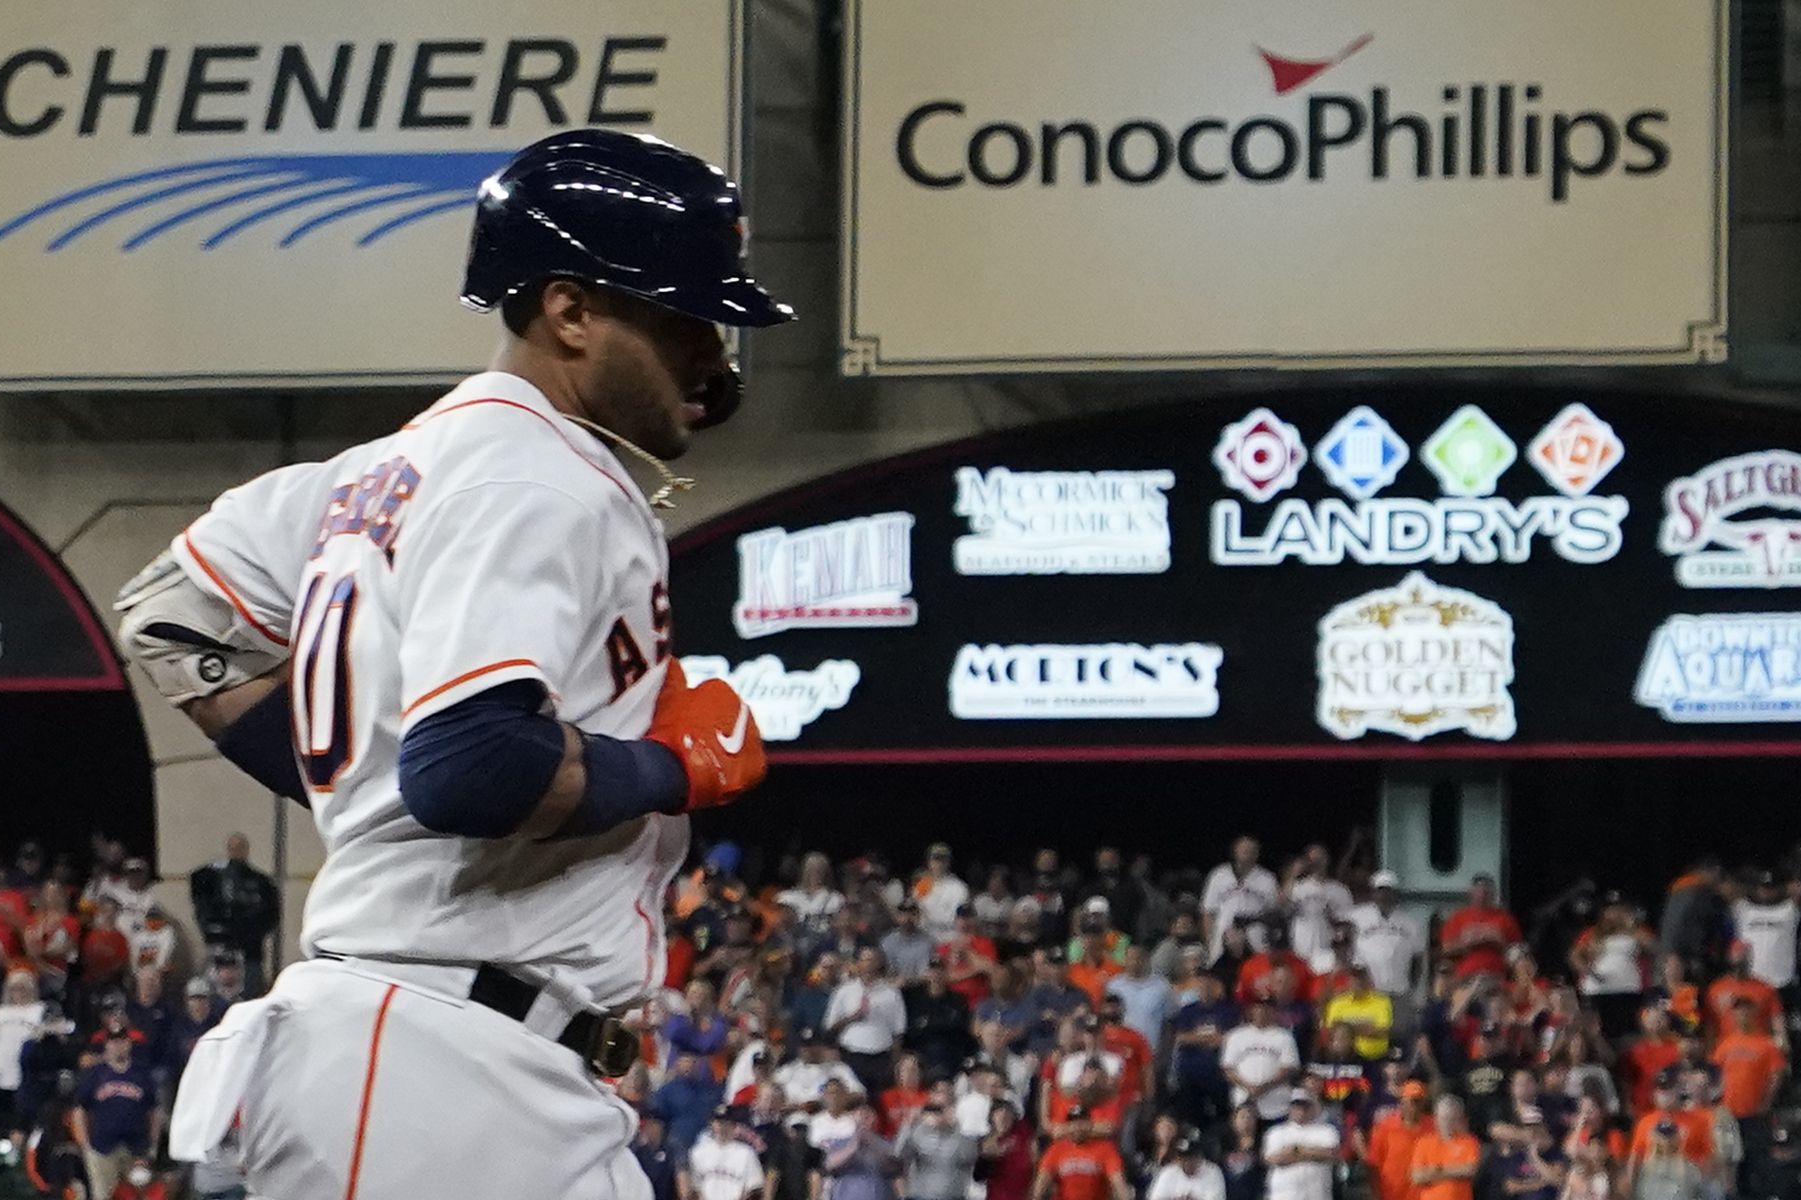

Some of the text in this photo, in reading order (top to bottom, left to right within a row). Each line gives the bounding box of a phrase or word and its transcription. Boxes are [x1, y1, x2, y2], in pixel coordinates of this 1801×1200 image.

[896, 84, 1672, 203] ConocoPhillips
[1218, 502, 1619, 560] LANDRY'S
[1329, 639, 1507, 665] GOLDEN
[1332, 670, 1500, 695] NUGGET
